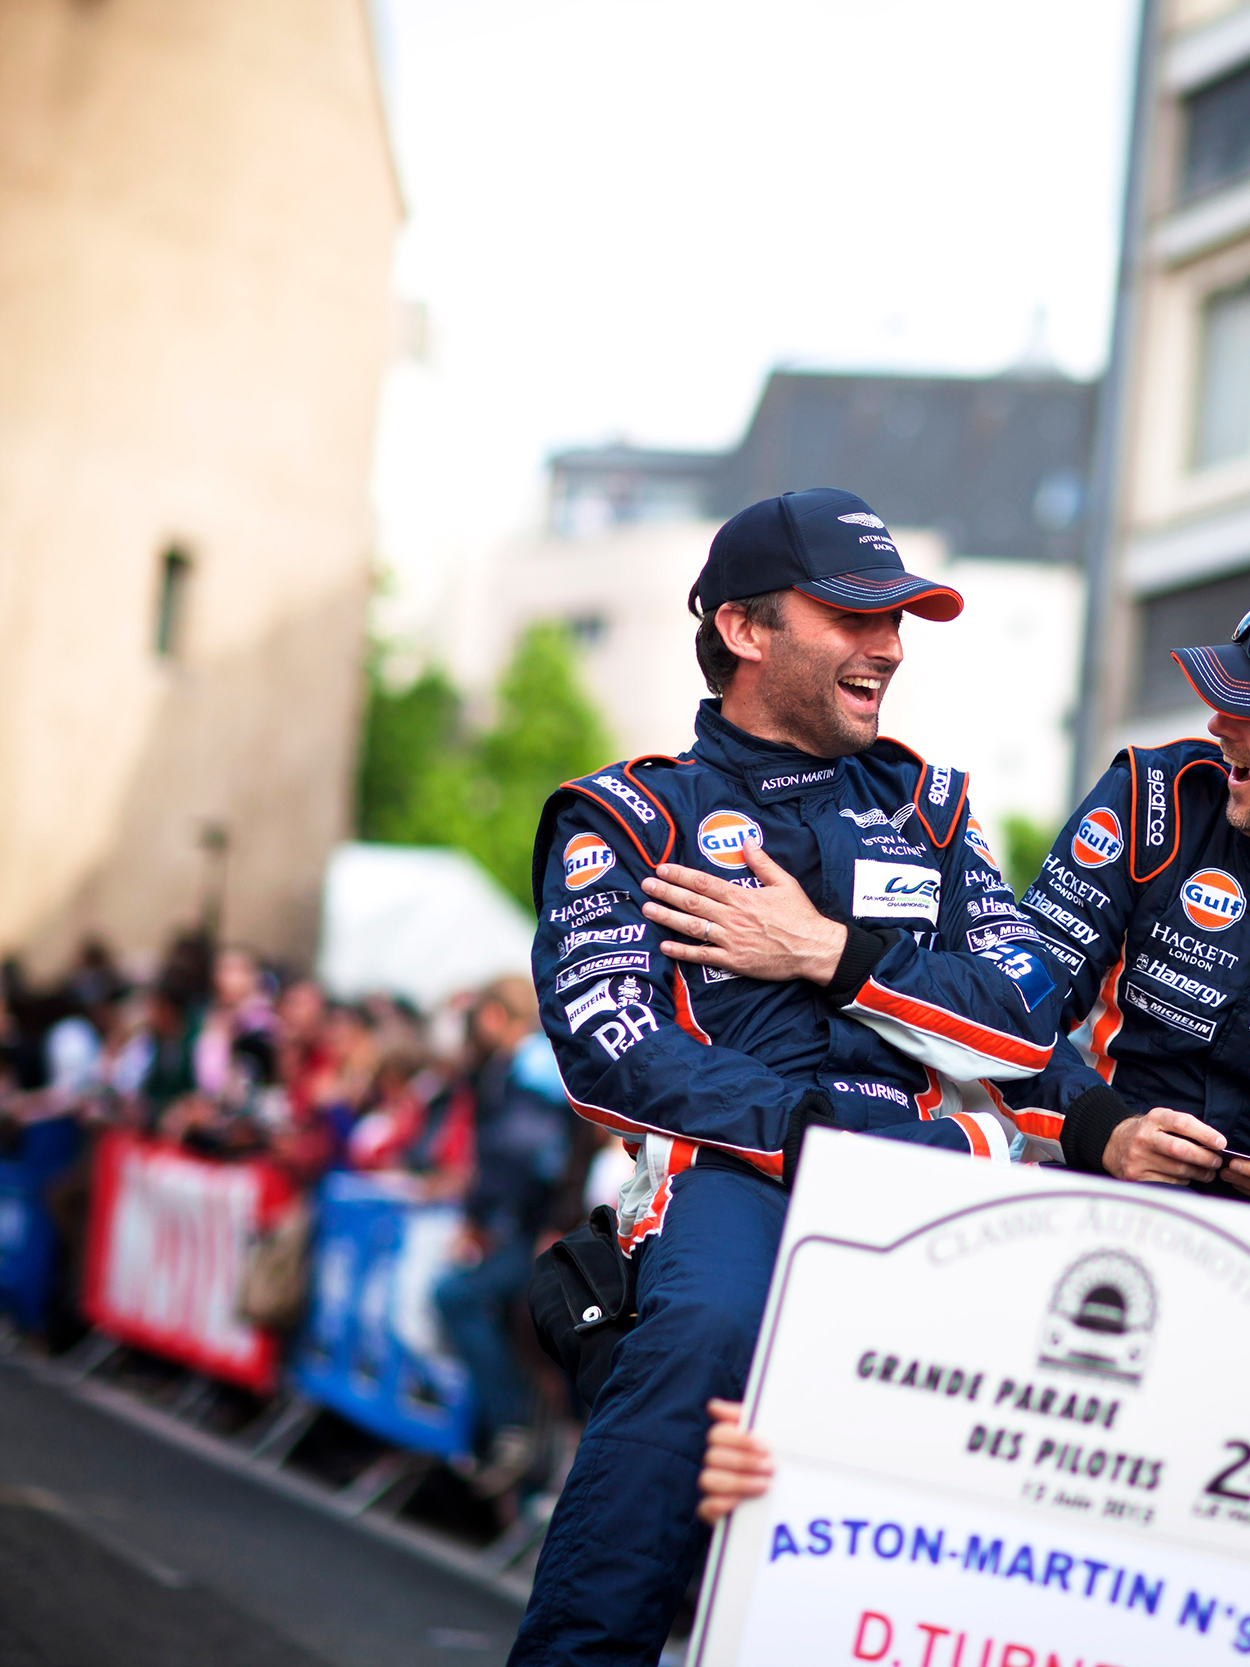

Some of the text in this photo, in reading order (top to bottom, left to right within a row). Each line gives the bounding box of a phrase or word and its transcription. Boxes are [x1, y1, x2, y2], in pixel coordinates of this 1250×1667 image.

[761, 768, 835, 790] ASTON MARTIN
[592, 775, 657, 824] sparco
[1147, 768, 1167, 847] sparco
[1079, 822, 1120, 857] Gulf
[566, 849, 612, 876] Gulf
[1042, 853, 1111, 910] HACKETT
[1048, 877, 1085, 908] LONDON
[571, 905, 612, 929] LONDON
[1029, 889, 1101, 946] Hanergy
[1185, 884, 1243, 917] Gulf
[562, 923, 647, 955] Hanergy
[1151, 921, 1239, 970] HACKETT
[579, 955, 645, 974] MICHELIN
[1168, 947, 1214, 973] LONDON
[1147, 959, 1228, 1008] Hanergy
[569, 990, 607, 1023] BILSTEIN
[1150, 1002, 1212, 1034] MICHELIN
[591, 1002, 660, 1062] P&H
[855, 1082, 910, 1110] TURNER
[856, 1349, 1120, 1430] GRANDE PARADE
[966, 1424, 1164, 1492] DES PILOTES
[769, 1518, 1165, 1616] ASTON-MARTIN
